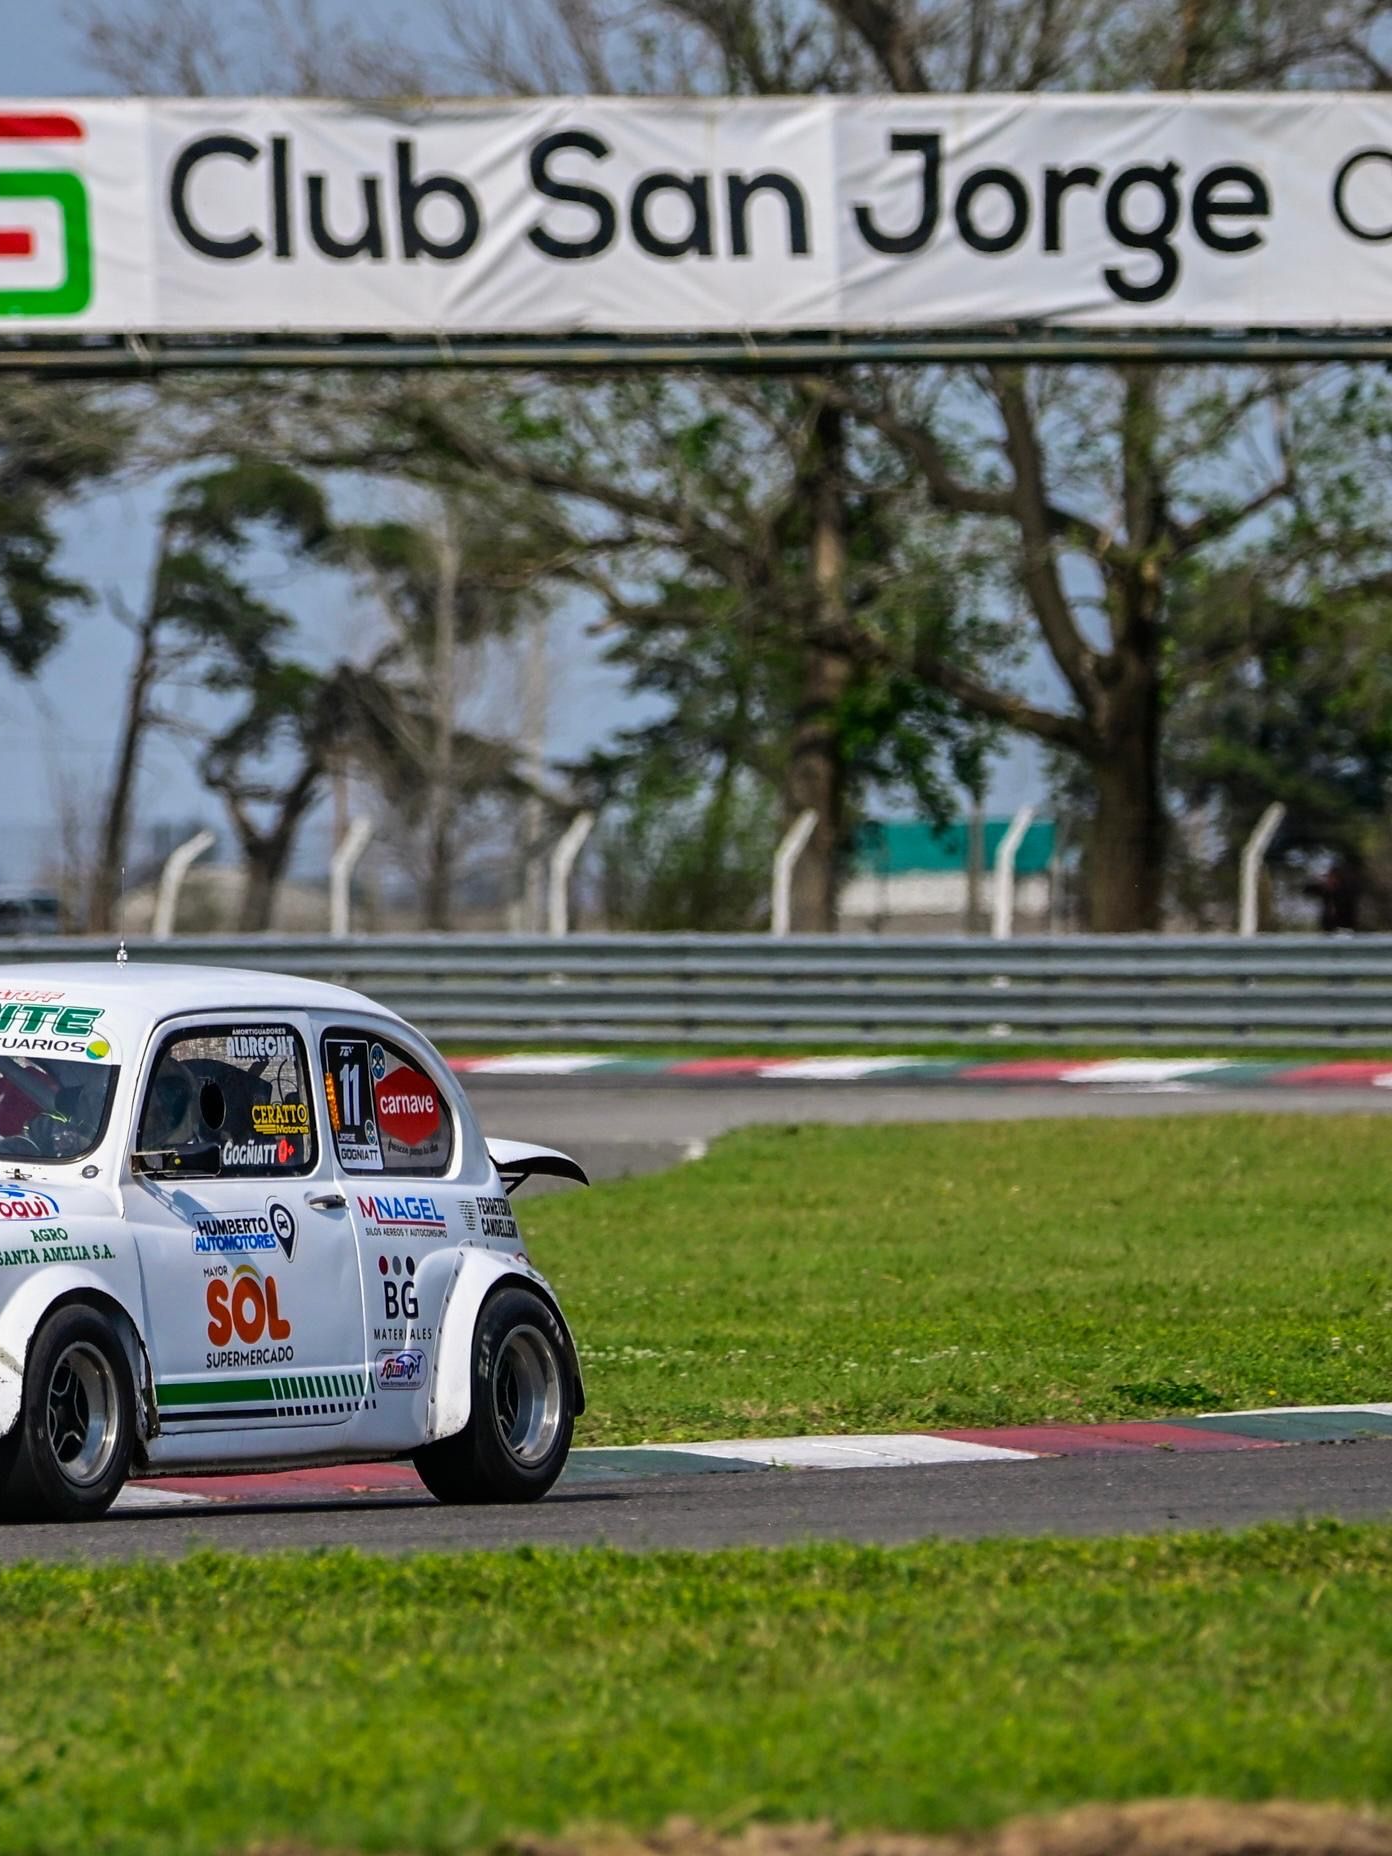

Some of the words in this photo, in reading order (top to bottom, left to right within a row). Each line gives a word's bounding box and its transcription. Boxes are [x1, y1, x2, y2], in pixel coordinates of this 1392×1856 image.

[171, 135, 480, 260] Club
[527, 131, 809, 261] San
[855, 132, 1270, 303] Jorge
[226, 1035, 295, 1057] ALBRECHT
[339, 1063, 361, 1126] 11
[379, 1094, 435, 1115] carnave
[251, 1103, 308, 1124] CERATTO
[275, 1124, 309, 1134] Motores
[30, 1227, 69, 1243] AGRO
[196, 1216, 269, 1237] HUMBERTO
[365, 1227, 382, 1237] SILOS
[195, 1233, 277, 1252] AUTOMOTORES
[43, 1246, 92, 1264] AMELIA
[93, 1244, 117, 1260] S.A.
[203, 1264, 228, 1278] MAYOR
[383, 1280, 420, 1320] BG
[206, 1275, 292, 1347] SOL
[373, 1327, 433, 1341] MATERIALES
[206, 1345, 294, 1370] SUPERMERCADO
